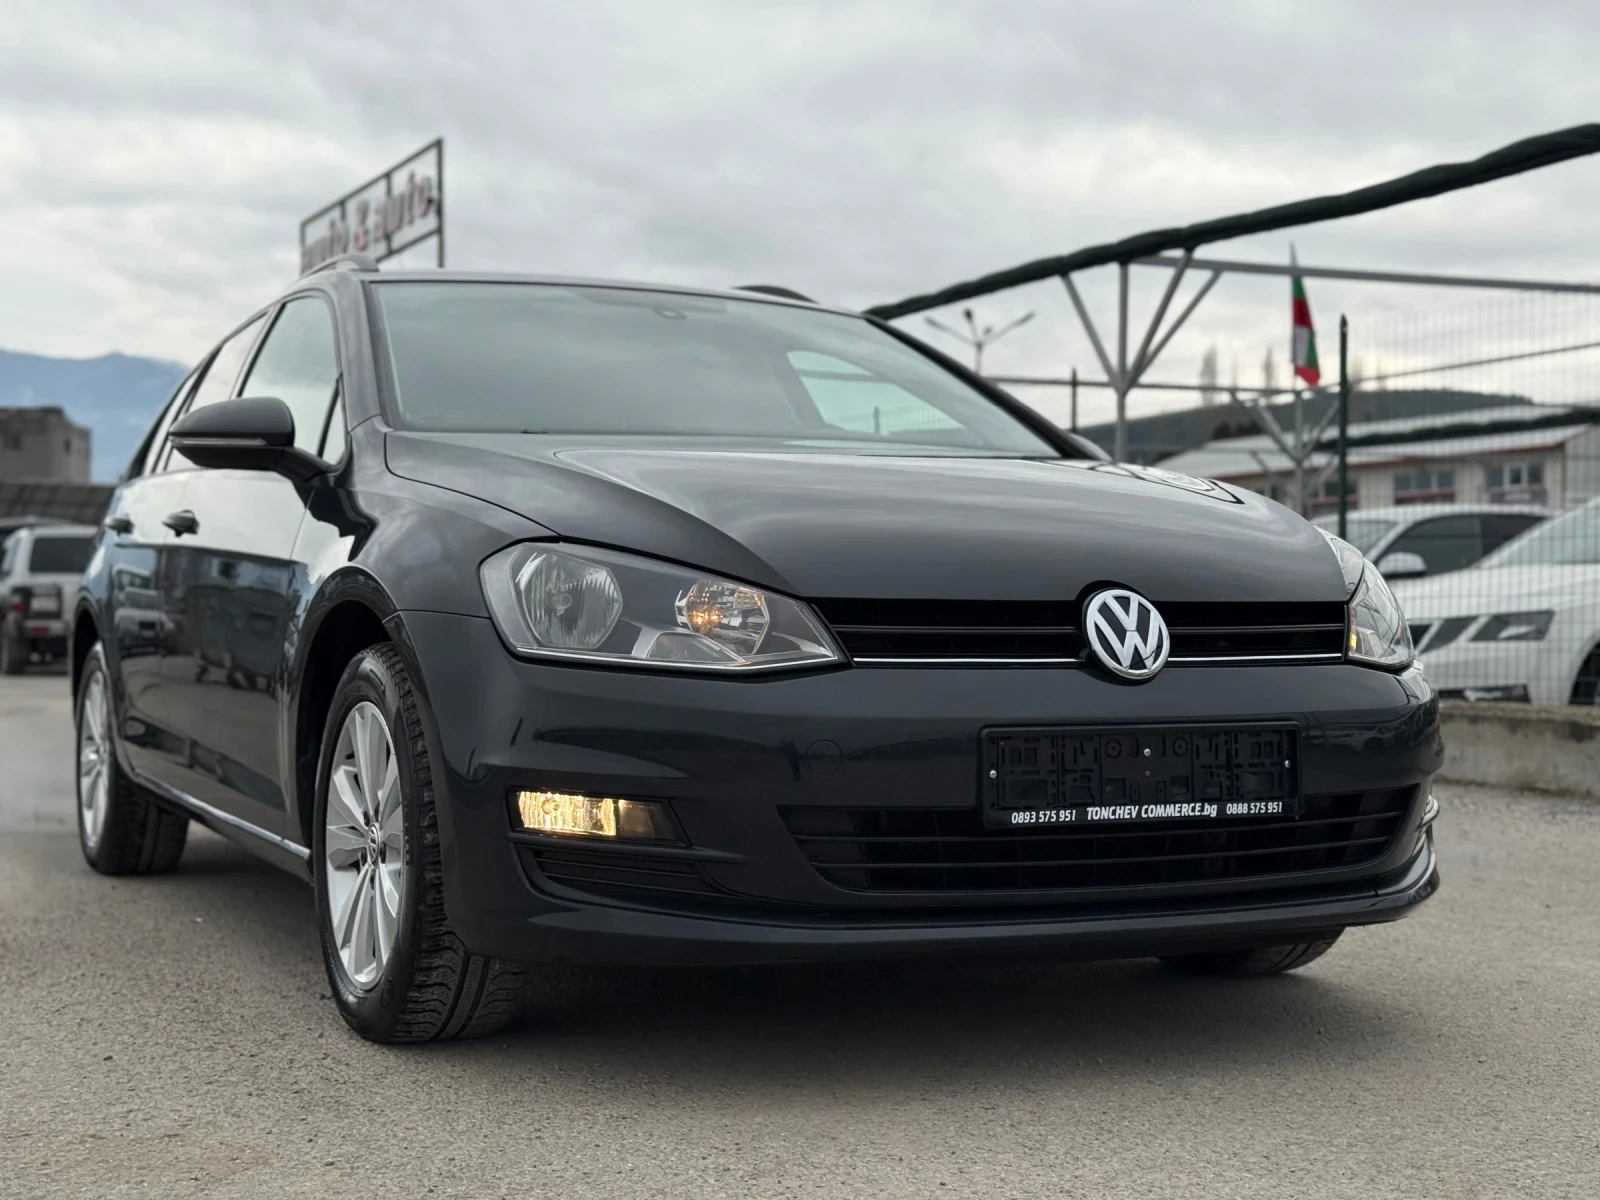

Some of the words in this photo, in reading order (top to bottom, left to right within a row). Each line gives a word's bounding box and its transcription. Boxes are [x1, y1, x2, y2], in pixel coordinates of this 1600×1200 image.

[1089, 590, 1167, 674] VW
[1011, 811, 1036, 824] 0893
[1038, 810, 1057, 823] 575
[1058, 809, 1077, 822] 951
[1086, 805, 1140, 821] TONCHEV
[1141, 802, 1218, 818] COMMERCE.bg
[1226, 802, 1249, 815] 0888
[1249, 801, 1266, 814] 575
[1267, 801, 1283, 813] 951
